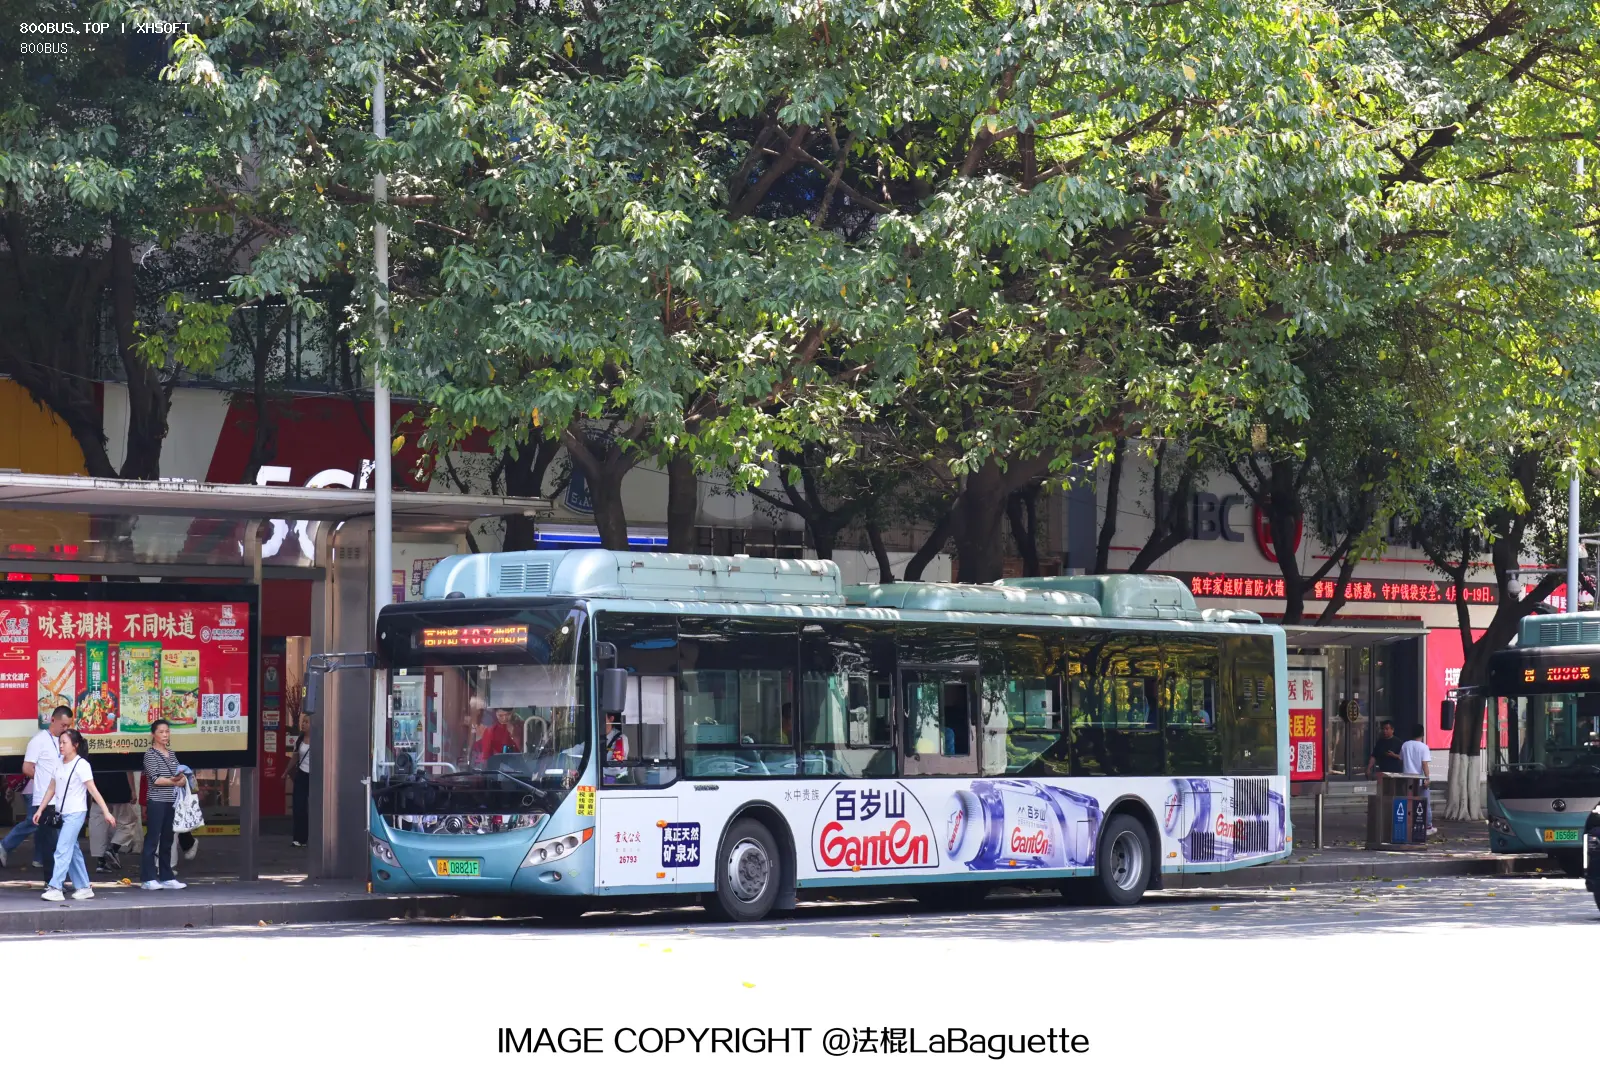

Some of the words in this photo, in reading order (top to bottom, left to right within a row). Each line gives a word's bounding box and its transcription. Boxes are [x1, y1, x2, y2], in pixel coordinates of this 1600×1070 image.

[1191, 576, 1285, 597] 筑牢家庭财富防火墙
[38, 611, 113, 639] 咏熹调料
[123, 611, 197, 639] 不同味道
[784, 788, 820, 802] 水中贵族
[835, 788, 906, 821] 百岁山
[614, 831, 641, 843] 重庆公交
[663, 826, 699, 842] 真正天然
[819, 819, 929, 868] Ganten
[619, 855, 637, 864] 26793
[663, 843, 699, 863] 矿泉水
